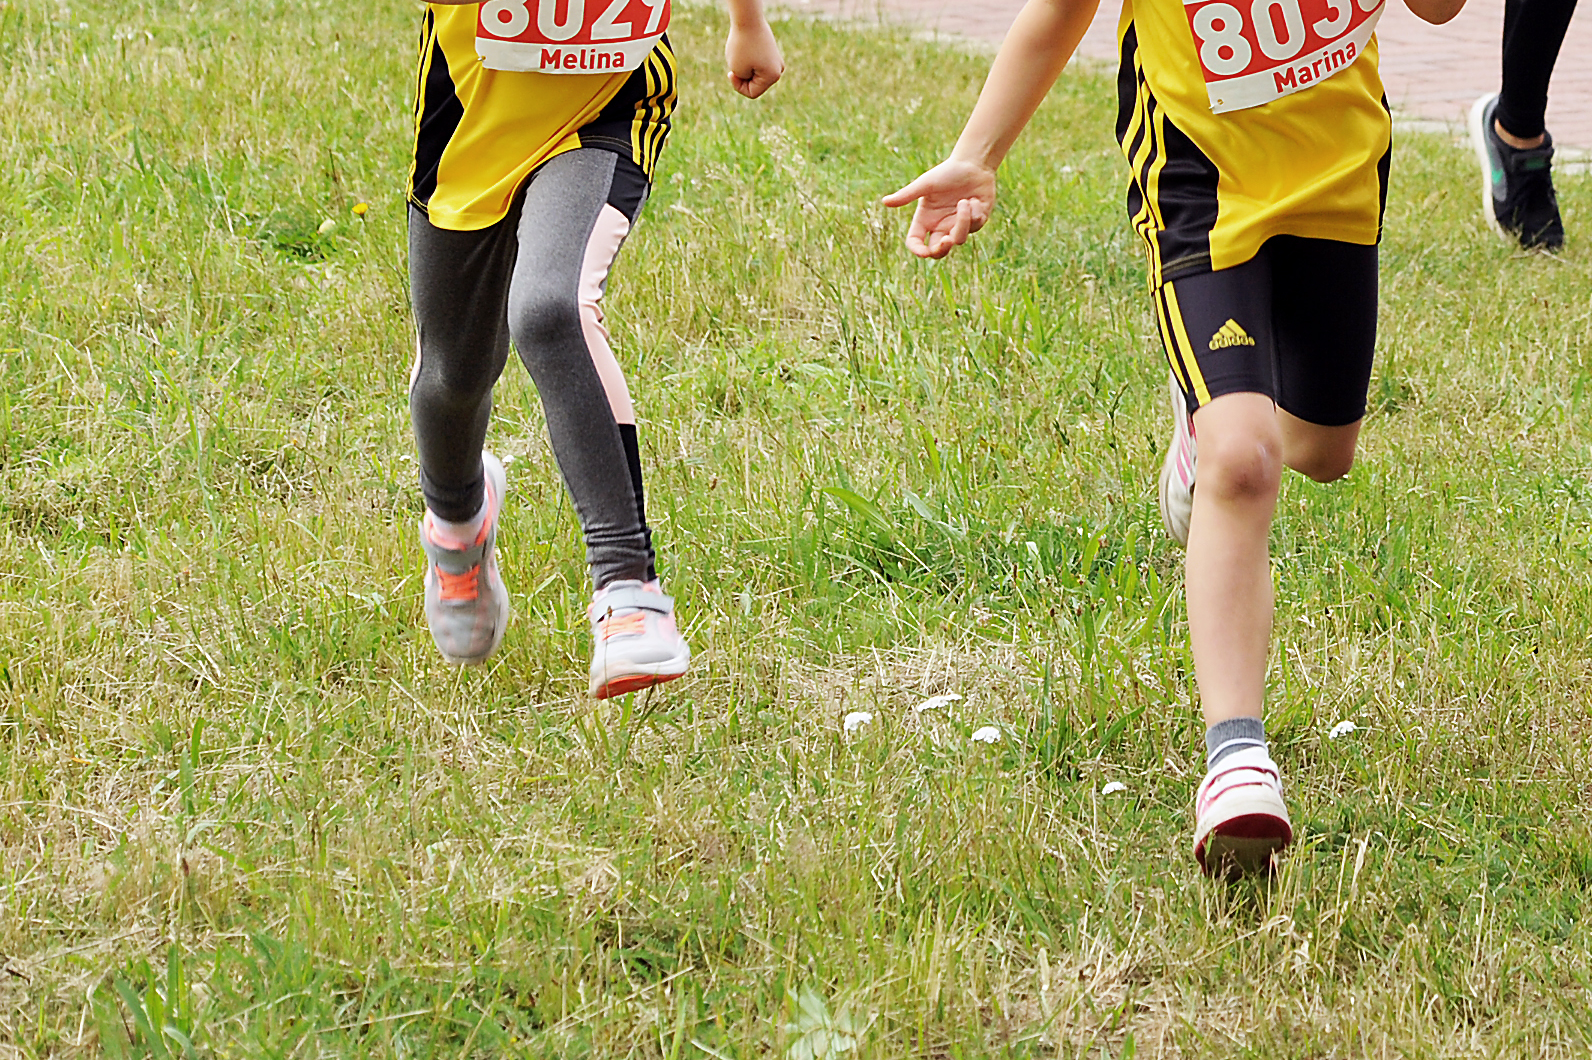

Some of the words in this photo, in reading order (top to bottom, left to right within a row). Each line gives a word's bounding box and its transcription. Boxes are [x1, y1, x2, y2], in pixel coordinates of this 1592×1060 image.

[539, 48, 626, 70] Melina
[1273, 41, 1357, 94] Marina
[1208, 336, 1256, 351] adidas
